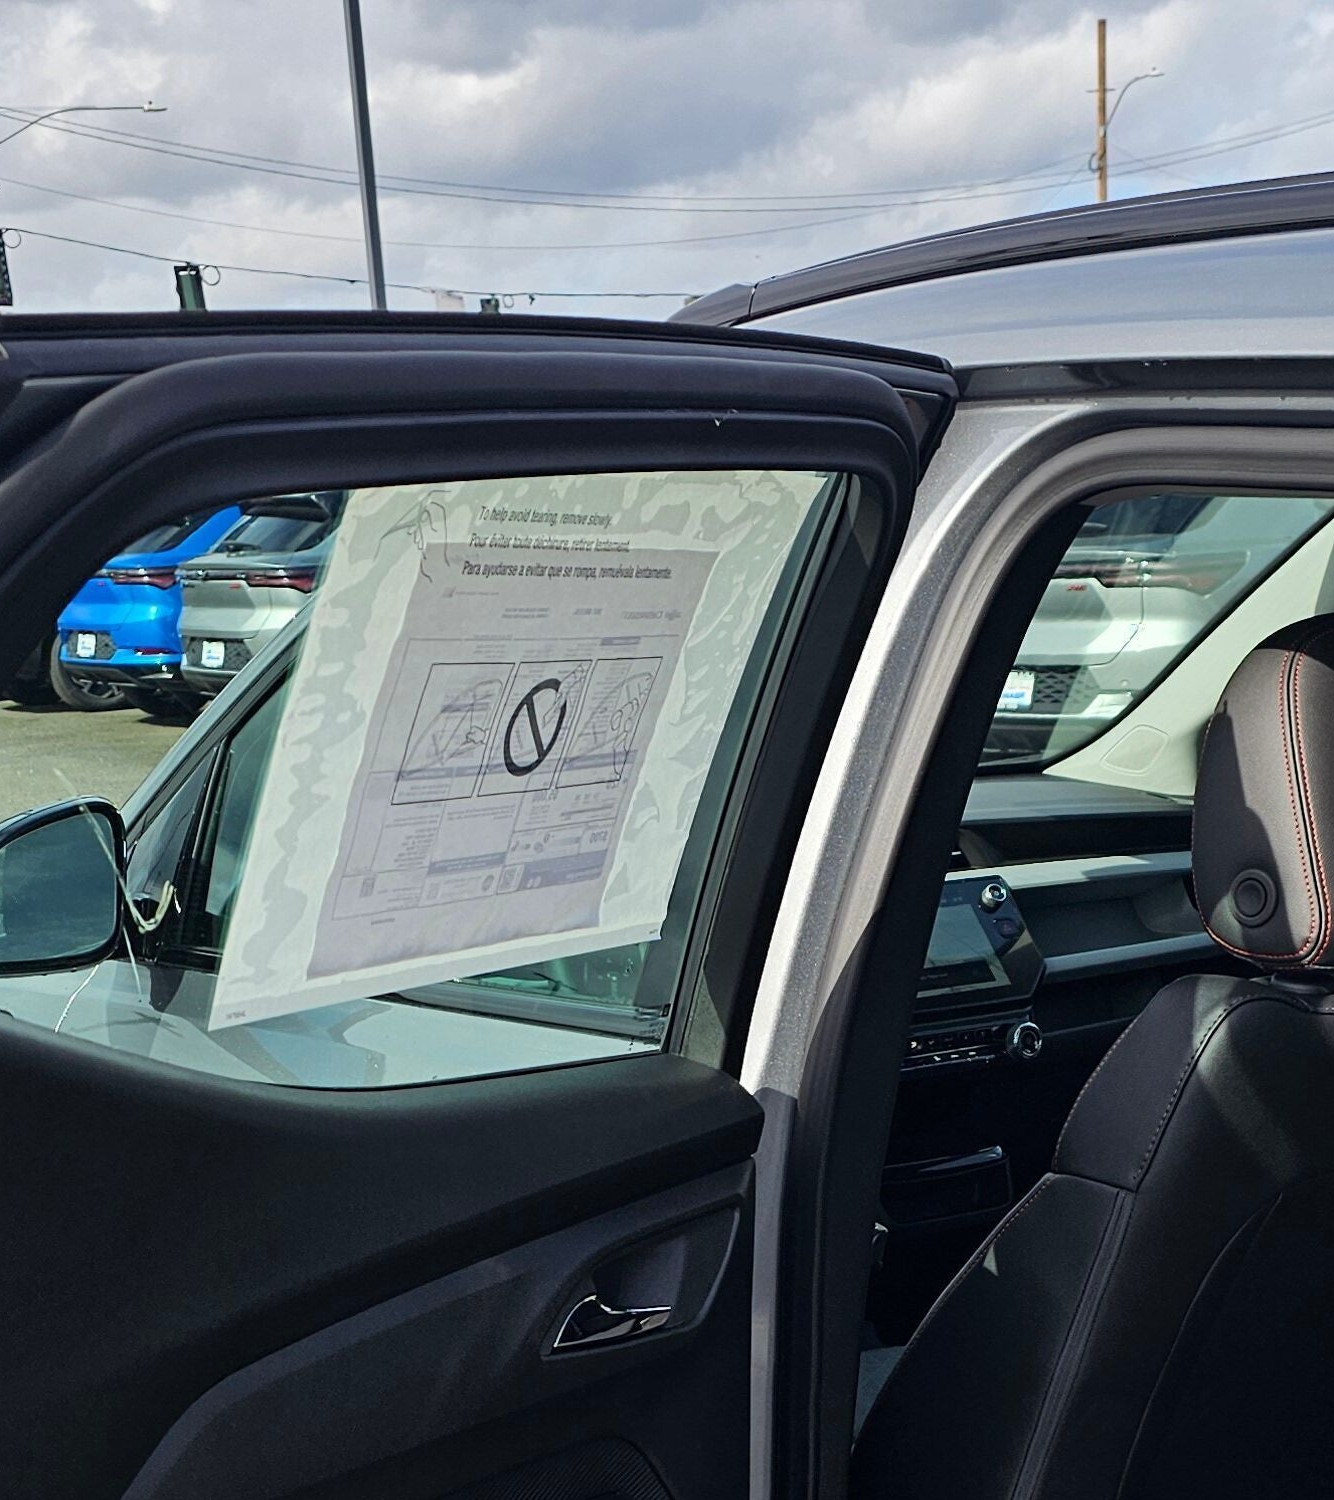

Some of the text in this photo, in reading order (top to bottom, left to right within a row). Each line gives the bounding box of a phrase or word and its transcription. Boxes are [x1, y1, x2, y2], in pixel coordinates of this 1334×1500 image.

[479, 504, 490, 521] To
[489, 506, 508, 525] help
[508, 507, 531, 523] avoid
[559, 512, 588, 525] remove
[469, 531, 488, 548] Pour
[488, 531, 512, 549] éviter
[511, 534, 532, 550] toute
[461, 560, 482, 576] Para
[481, 561, 518, 578] ayudarse
[517, 564, 526, 577] a
[525, 562, 548, 577] evitar
[546, 564, 564, 581] que
[562, 565, 574, 577] se
